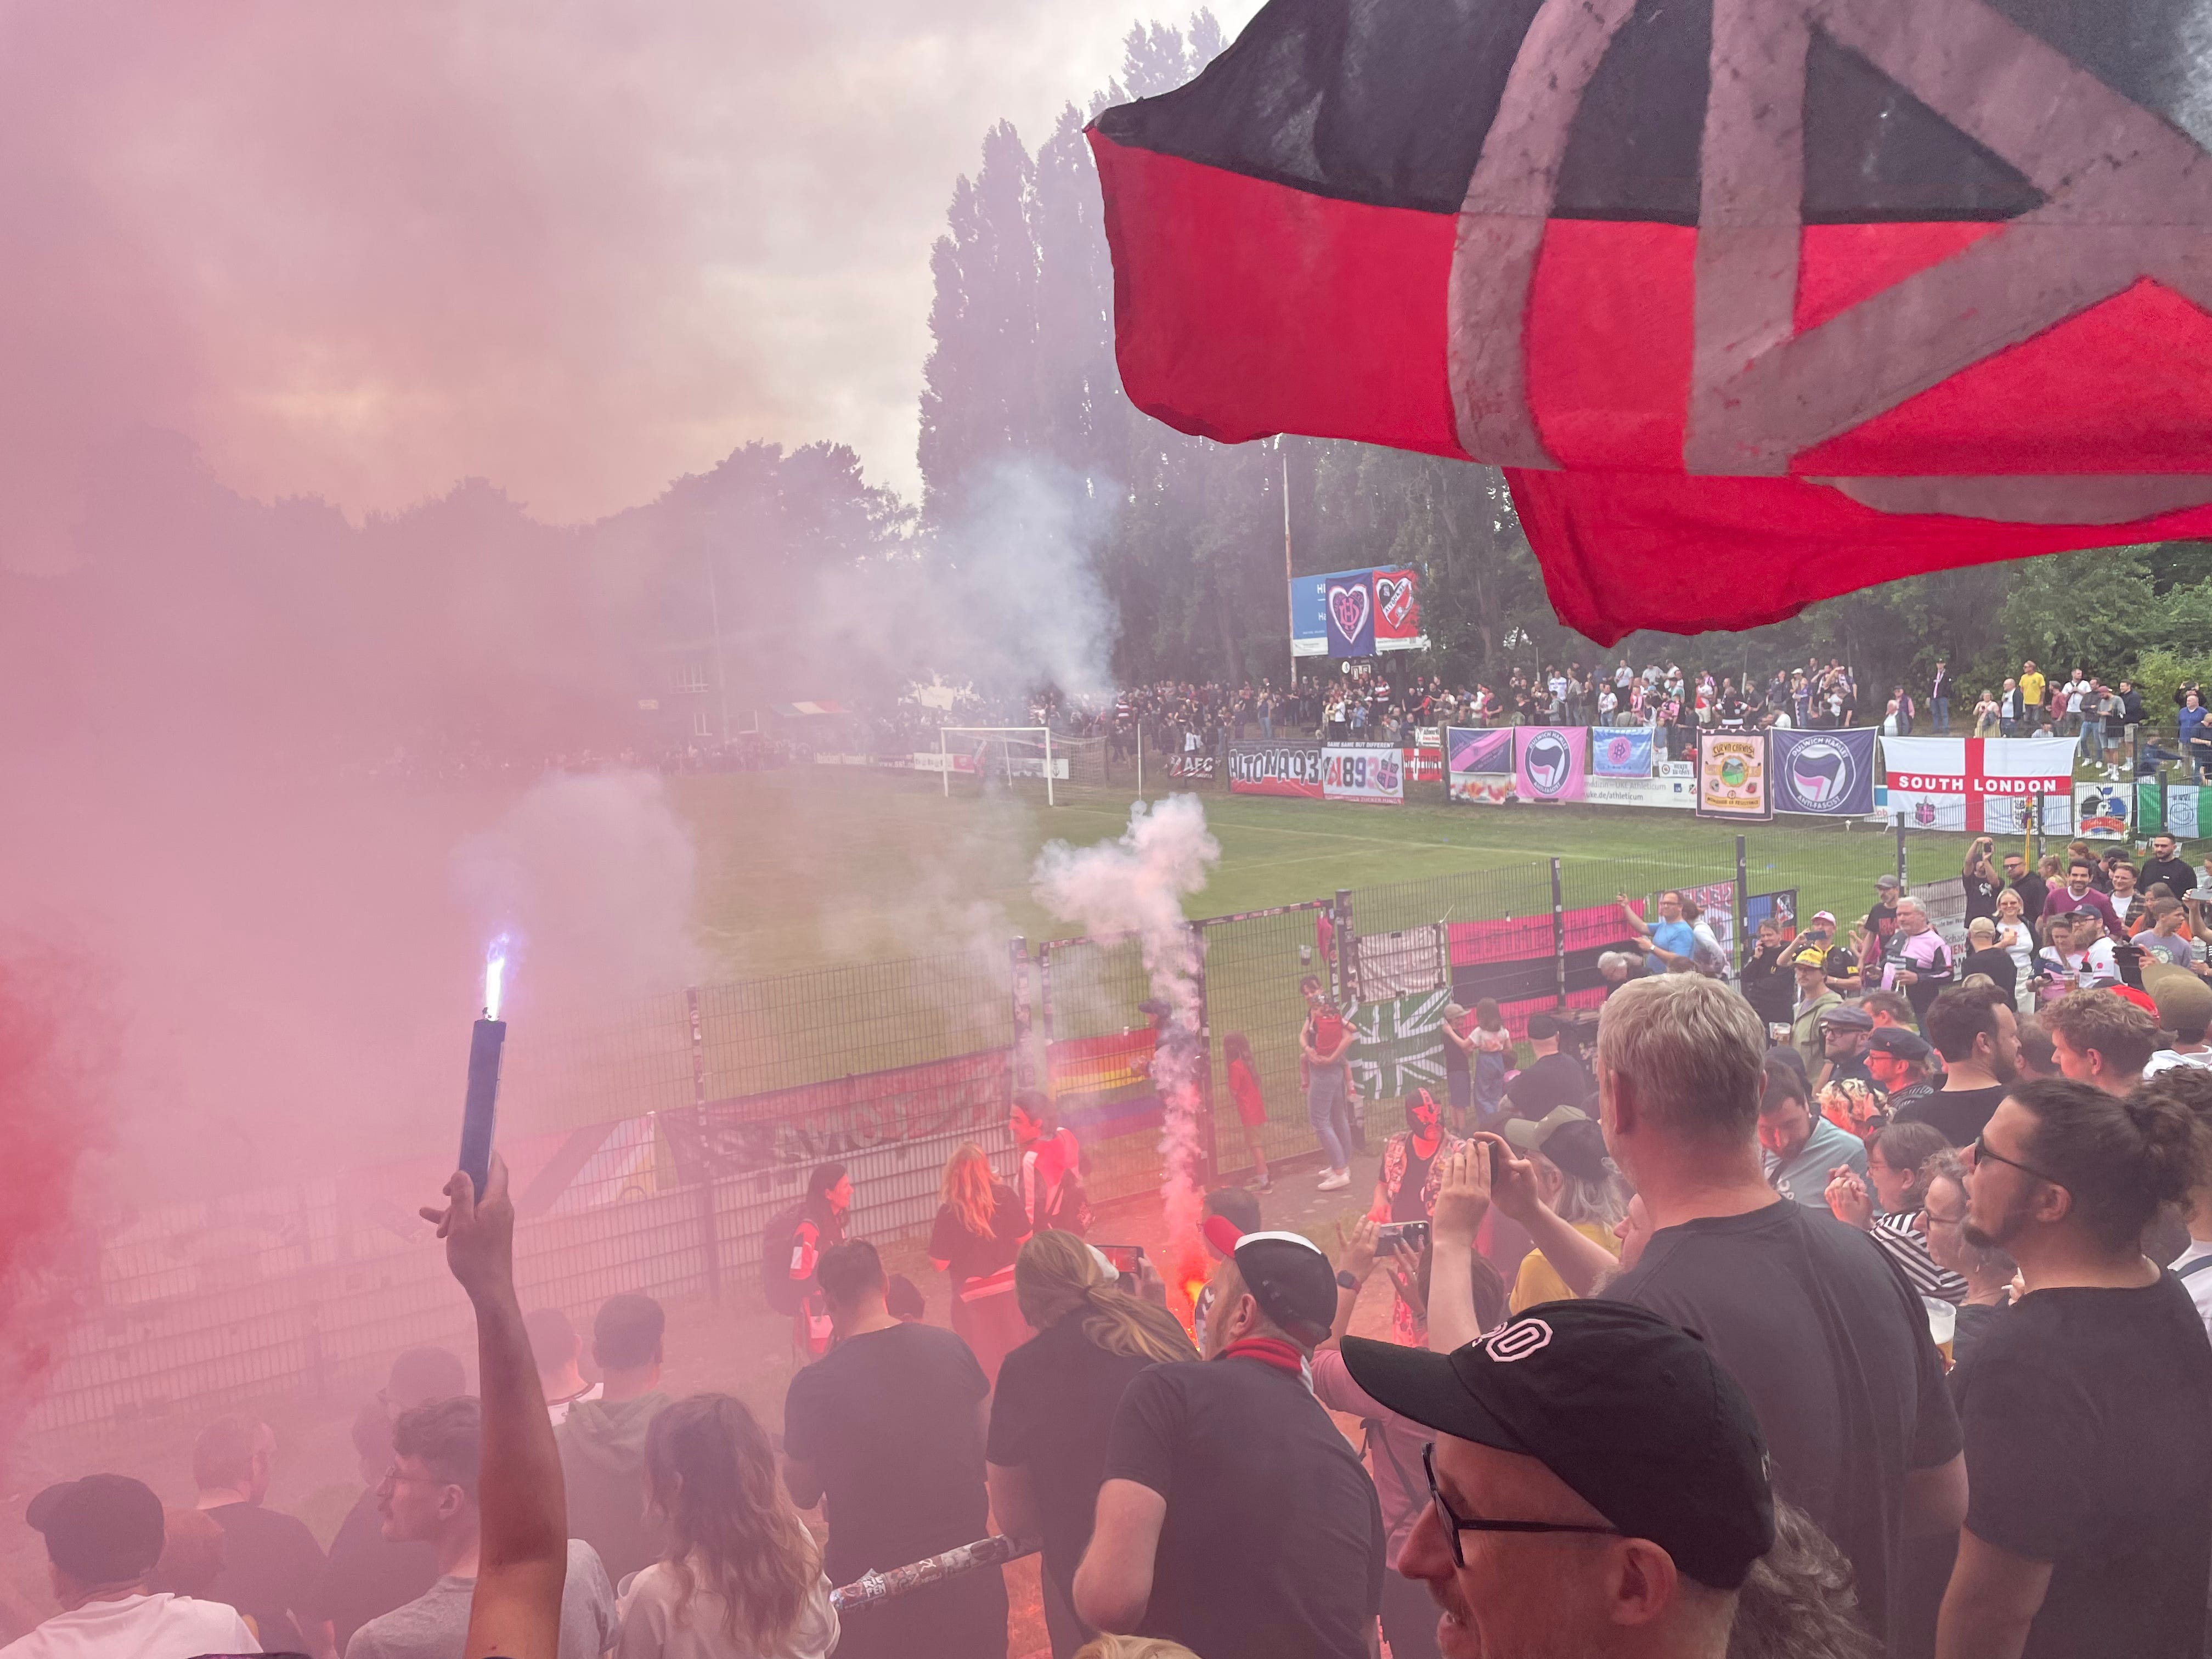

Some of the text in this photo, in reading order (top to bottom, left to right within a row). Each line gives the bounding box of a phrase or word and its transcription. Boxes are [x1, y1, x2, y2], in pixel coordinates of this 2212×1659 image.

[1529, 732, 1568, 750] DULWICH HAMLET
[1713, 744, 1731, 754] CURVA
[1791, 738, 1849, 758] DULWICH HAMLET
[1228, 749, 1319, 786] ALTONA 93
[1405, 755, 1440, 775] ALTONA
[1899, 775, 2056, 793] SOUTH LONDON
[1797, 795, 1841, 810] ANTI-FASCIST
